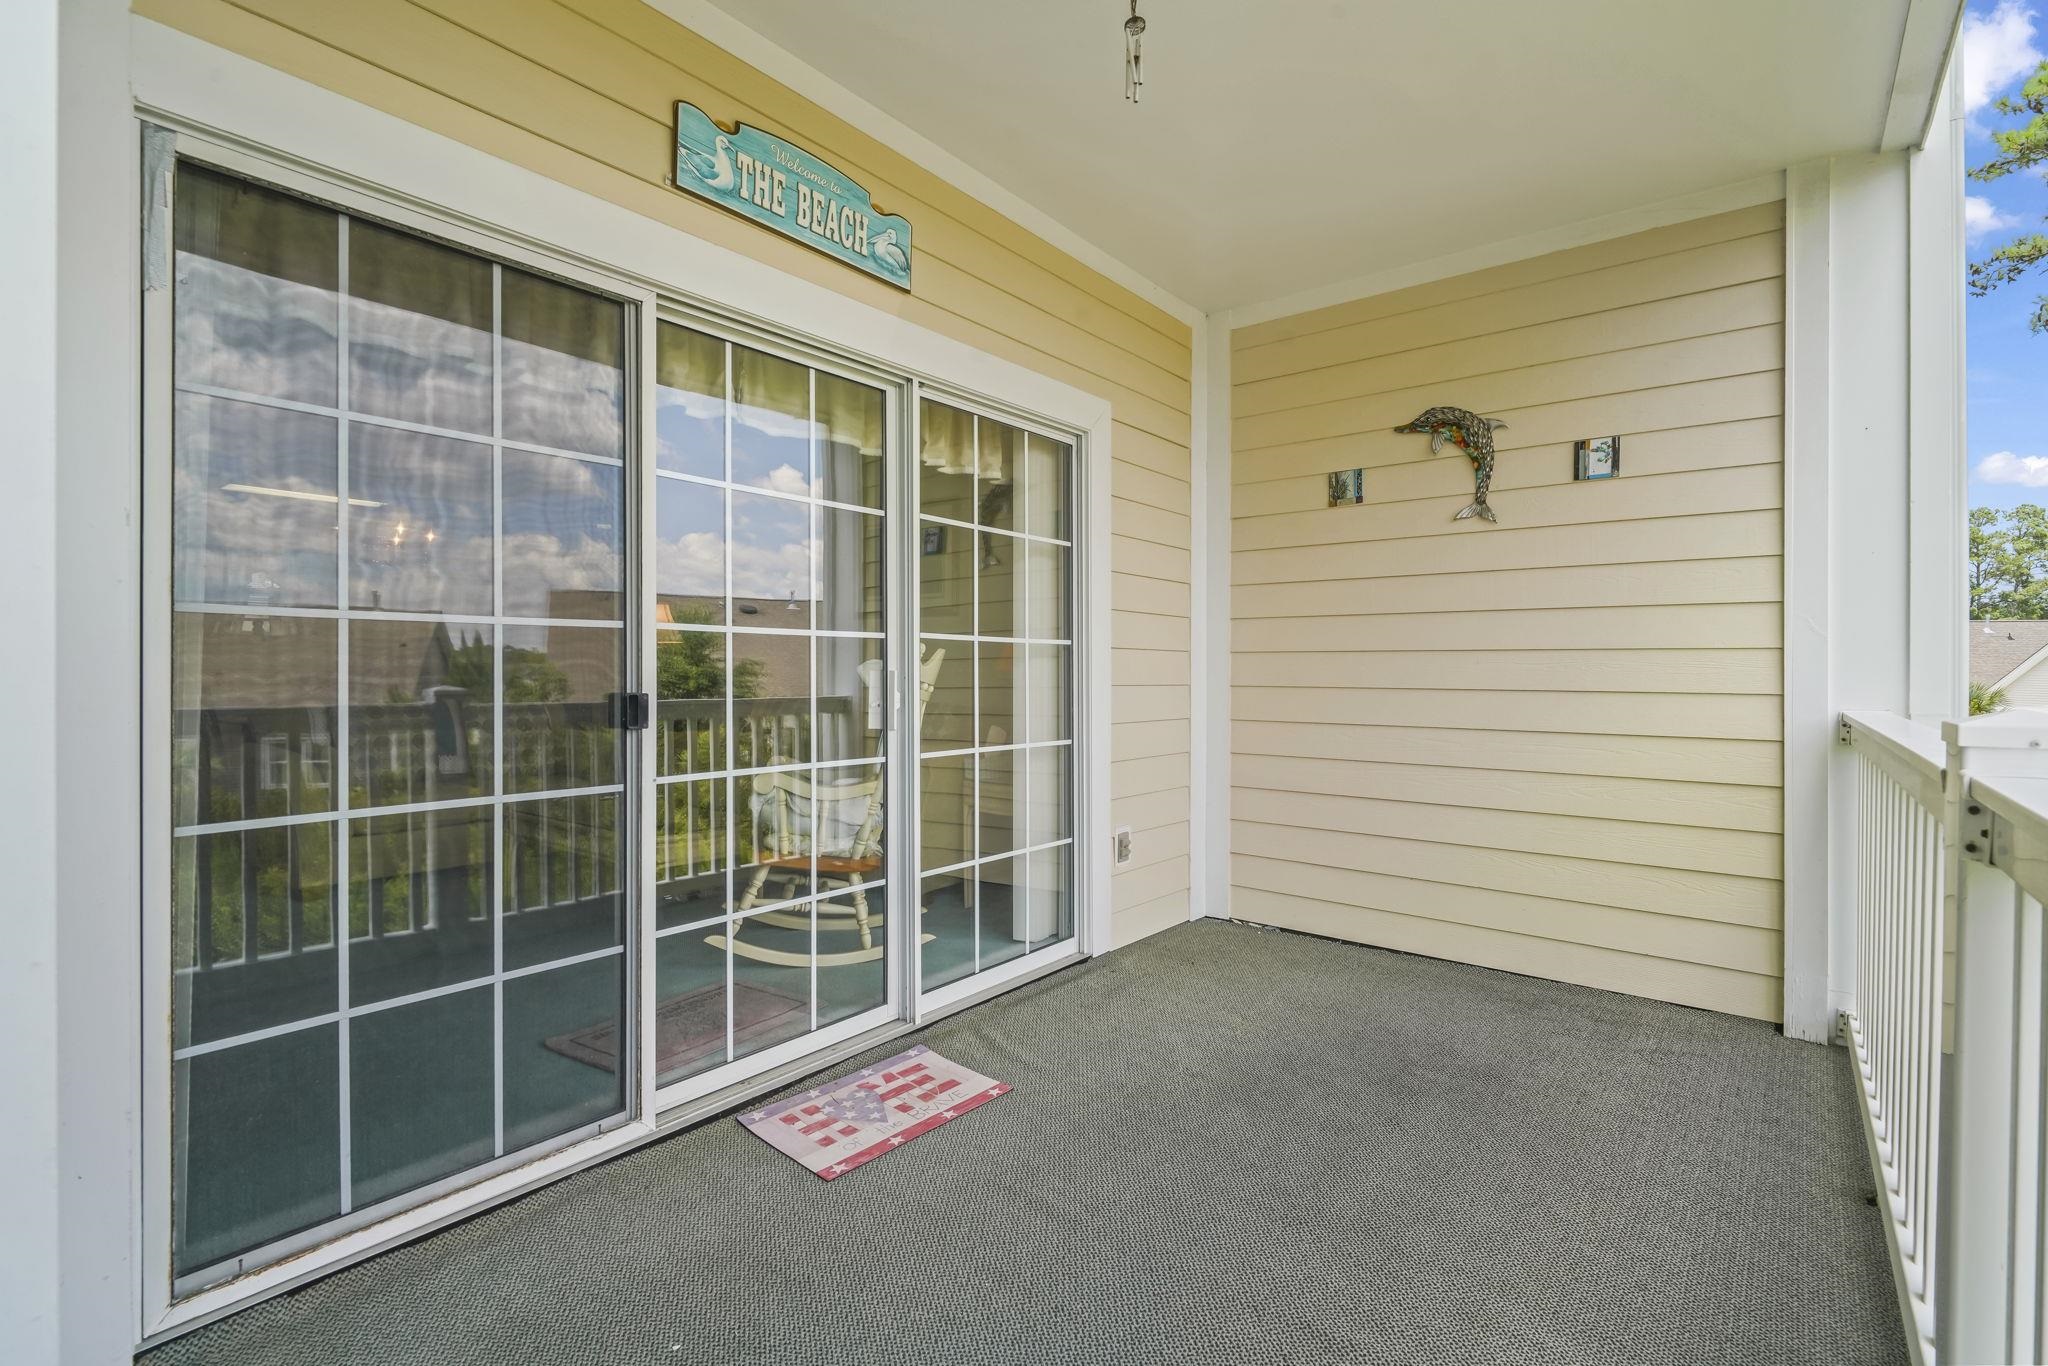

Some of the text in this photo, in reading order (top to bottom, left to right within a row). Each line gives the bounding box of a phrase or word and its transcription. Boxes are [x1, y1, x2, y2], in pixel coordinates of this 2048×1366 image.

[771, 144, 842, 195] Welcome to
[736, 152, 869, 257] THE BEACH
[875, 1120, 903, 1134] the
[907, 1089, 968, 1120] BRAVE
